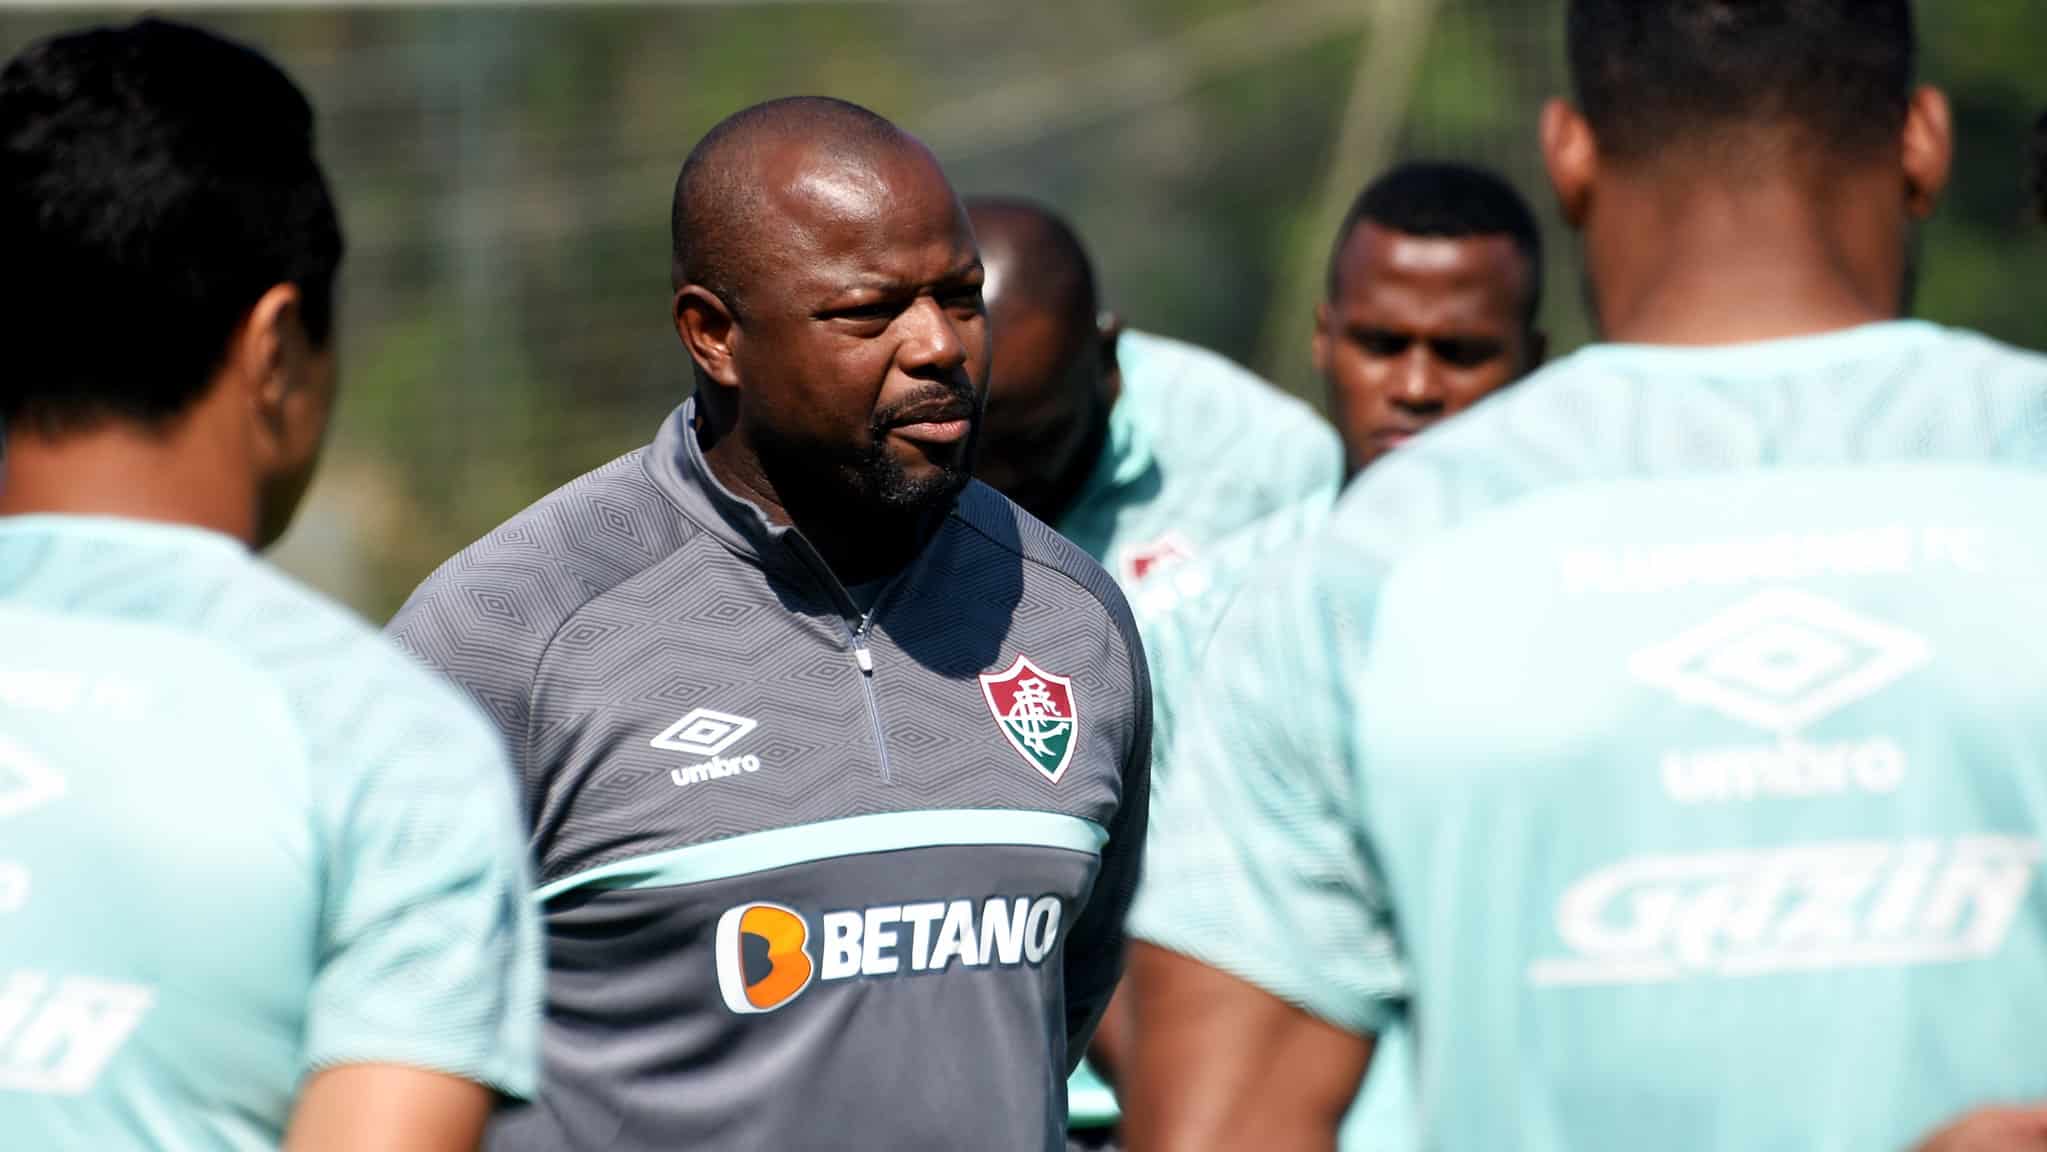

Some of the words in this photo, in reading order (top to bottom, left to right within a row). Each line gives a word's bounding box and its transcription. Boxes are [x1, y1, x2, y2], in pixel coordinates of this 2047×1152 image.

[671, 754, 760, 786] umbro
[1660, 734, 1907, 803] umbro
[820, 896, 1062, 981] BETANO
